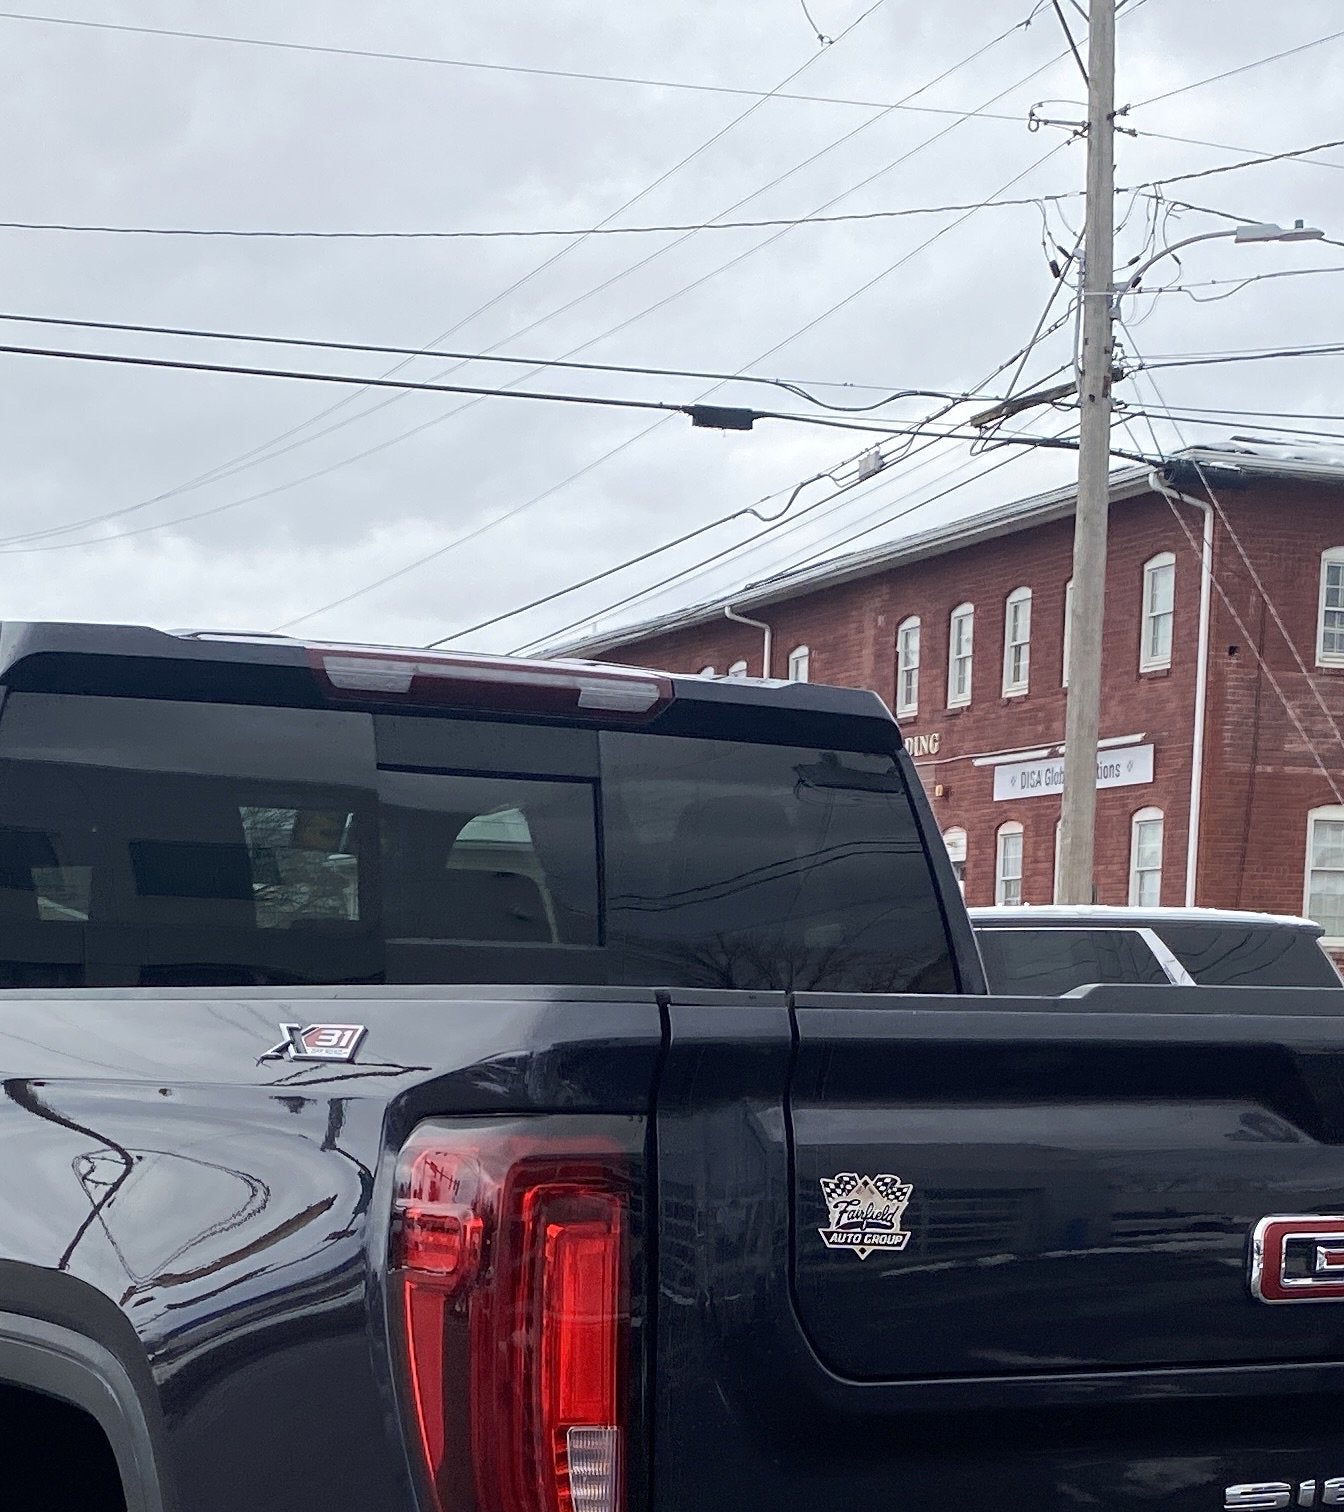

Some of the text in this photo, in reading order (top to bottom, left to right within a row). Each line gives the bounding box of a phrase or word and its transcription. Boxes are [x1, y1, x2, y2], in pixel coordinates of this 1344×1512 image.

[904, 733, 941, 757] DING
[1020, 762, 1122, 790] DISA Glob tions
[833, 1199, 899, 1230] Fairfield
[829, 1233, 904, 1245] AUTO GROUP
